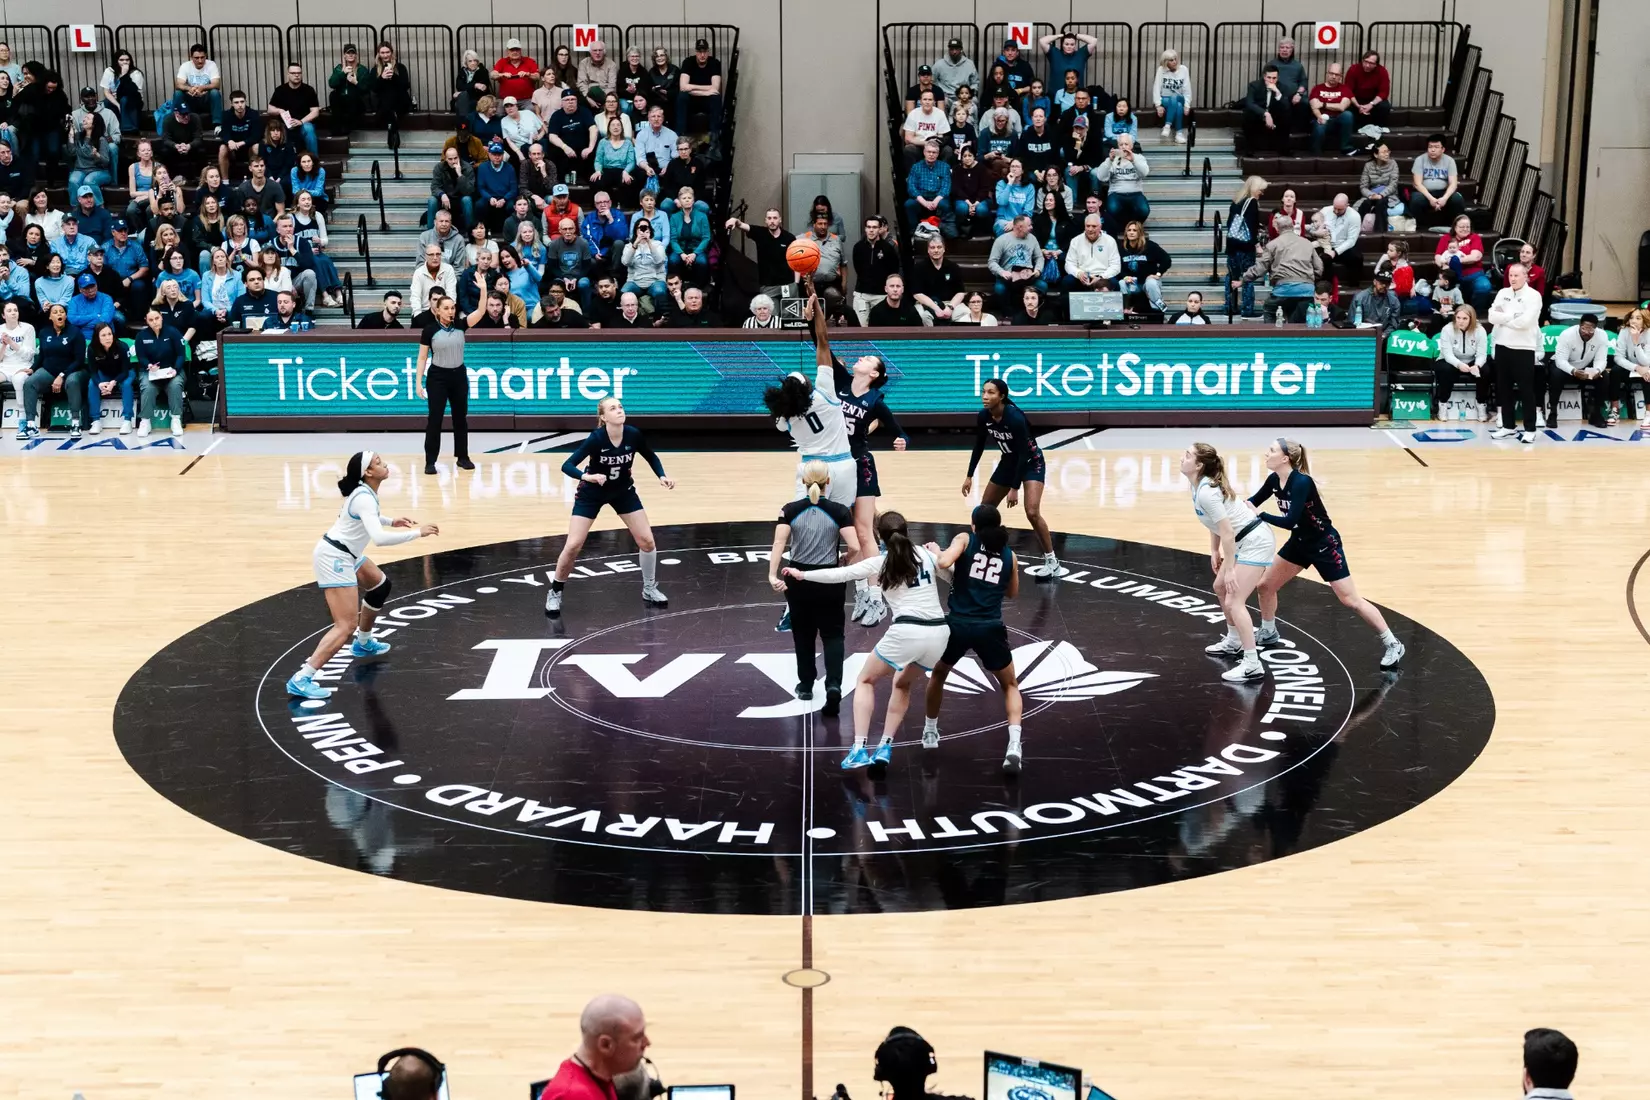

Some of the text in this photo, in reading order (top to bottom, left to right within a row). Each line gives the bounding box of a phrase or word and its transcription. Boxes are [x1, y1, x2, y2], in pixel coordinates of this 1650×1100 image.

[75, 29, 91, 47] L
[575, 28, 596, 47] M
[1012, 27, 1028, 45] N
[1318, 26, 1337, 44] O
[918, 122, 936, 131] PENN
[1422, 167, 1448, 178] PENN
[1391, 335, 1415, 352] Ivy
[268, 356, 630, 401] Ticketmarter
[840, 401, 868, 420] ENN
[1394, 399, 1415, 412] Ivy
[805, 411, 824, 435] 0
[988, 428, 1014, 441] PENN
[20, 437, 187, 451] TIAA
[997, 440, 1013, 454] 11
[599, 453, 634, 466] PENN
[609, 466, 621, 480] 5
[968, 552, 1004, 585] 22
[291, 712, 405, 775] PENN
[866, 743, 1281, 843] DARTMOUTH
[425, 785, 776, 844] HARVARD
